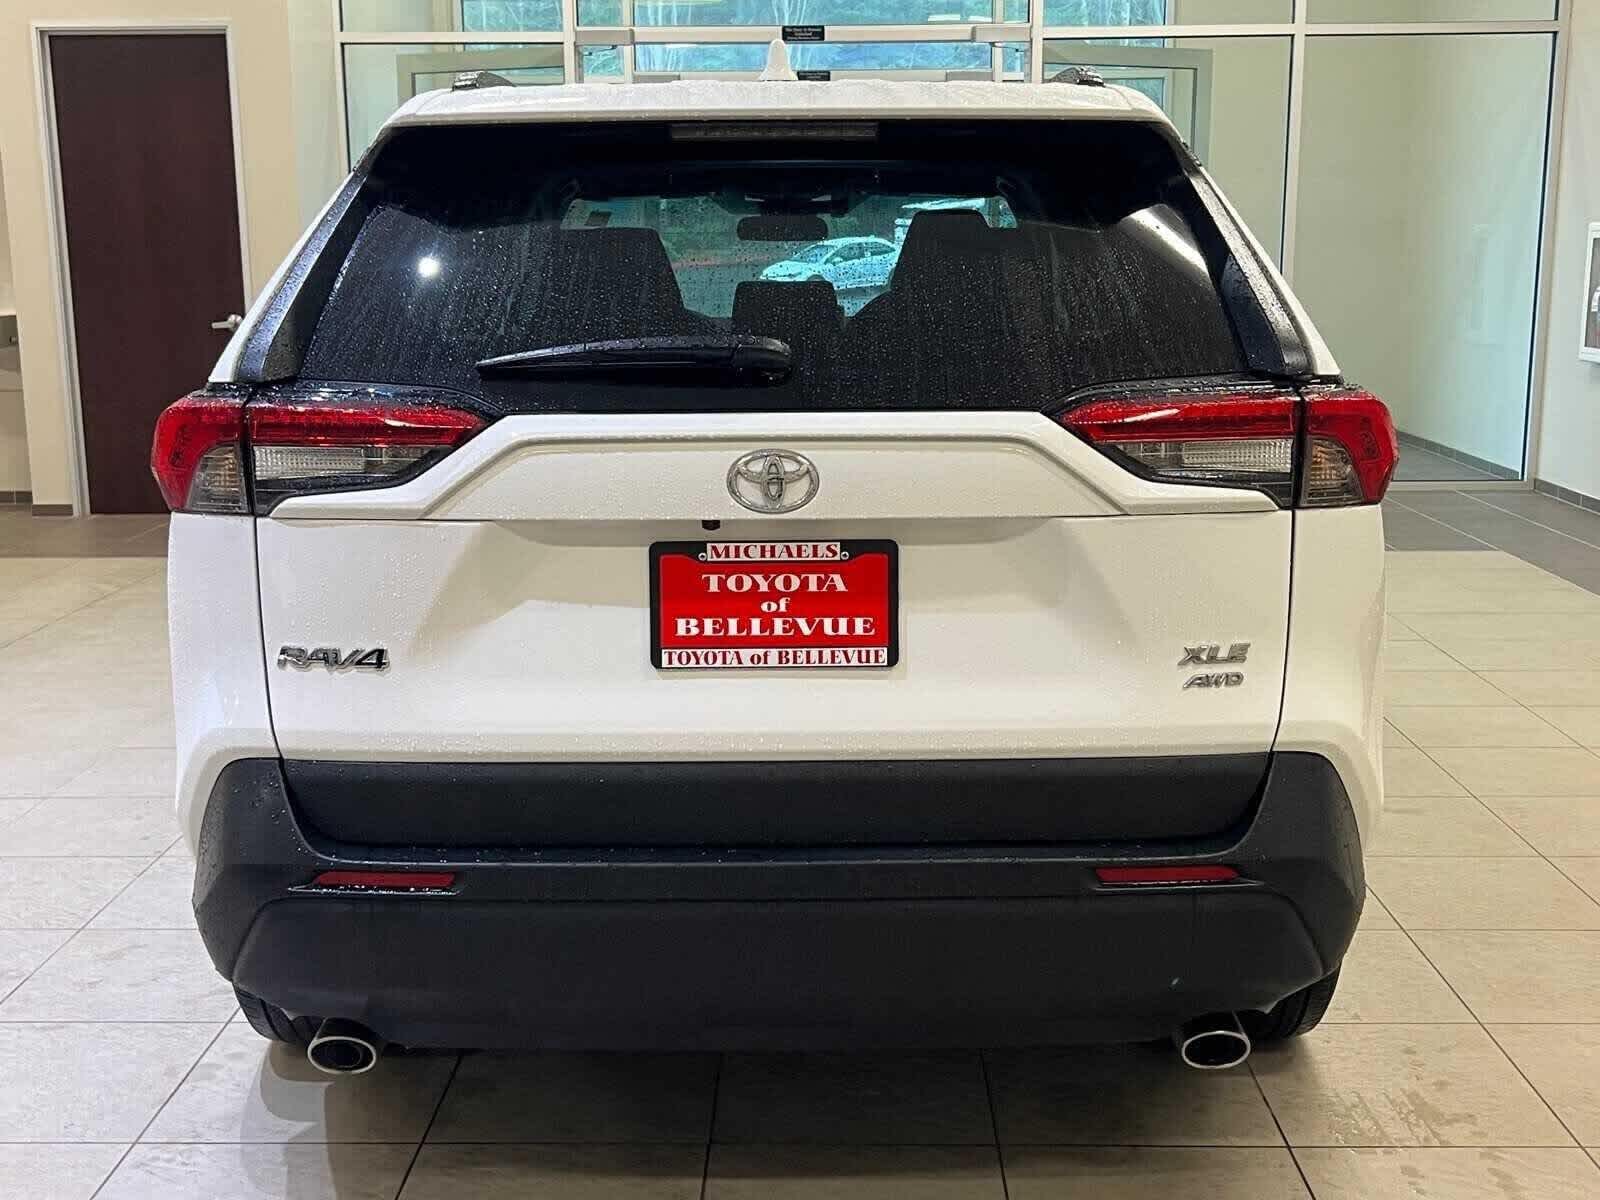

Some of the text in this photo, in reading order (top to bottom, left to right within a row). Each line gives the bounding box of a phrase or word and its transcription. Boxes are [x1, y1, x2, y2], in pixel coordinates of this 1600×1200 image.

[710, 544, 838, 559] MICHAELS
[701, 573, 848, 593] TOYOTA
[760, 597, 790, 613] of
[675, 617, 875, 636] BELLEVUE
[278, 646, 389, 671] RAV4
[664, 649, 886, 666] TOYOTA of BELLEVUE
[1178, 643, 1250, 665] XLE
[1183, 672, 1244, 689] AWD
